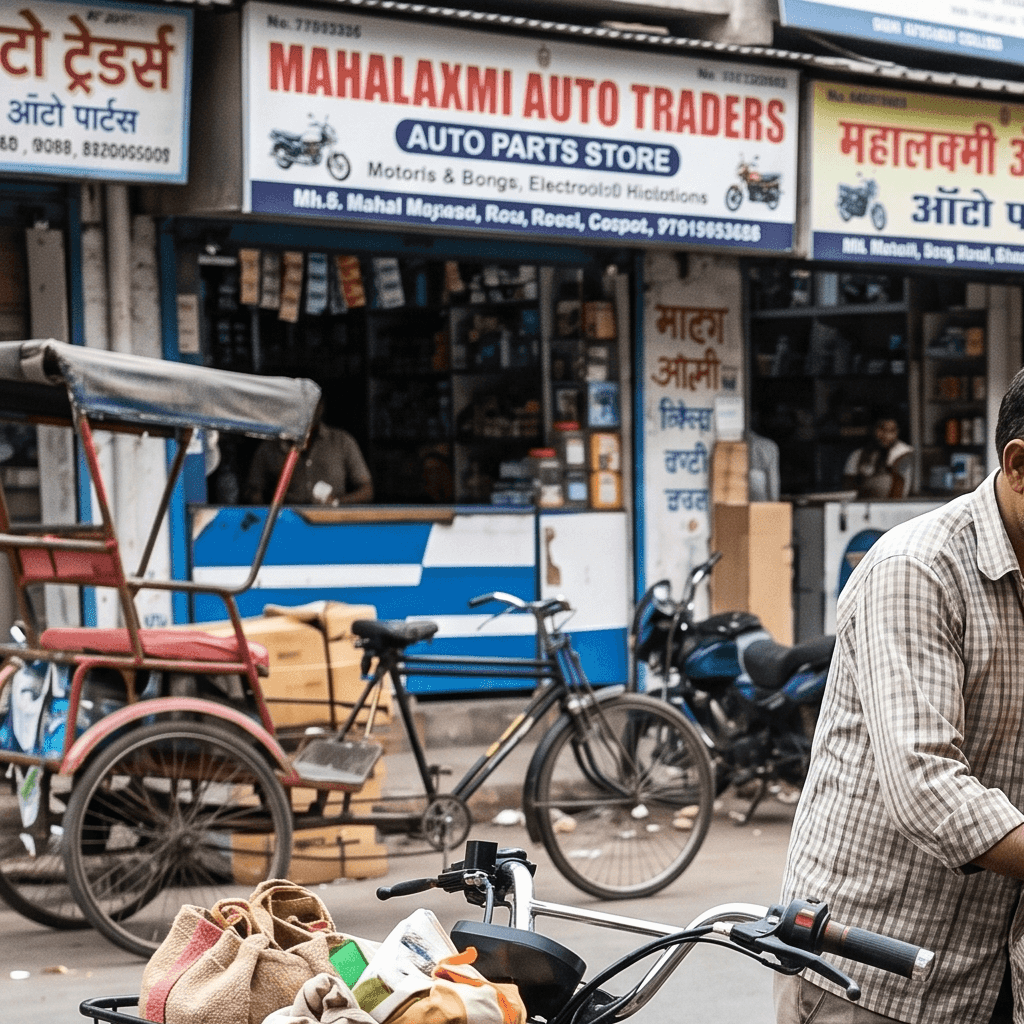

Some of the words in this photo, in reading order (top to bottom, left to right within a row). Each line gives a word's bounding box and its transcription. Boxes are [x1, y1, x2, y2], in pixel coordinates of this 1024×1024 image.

[269, 42, 512, 116] MAHALAXMI
[523, 73, 619, 127] AUTO
[630, 84, 785, 143] TRADERS
[406, 123, 486, 156] AUTO
[491, 131, 579, 165] PARTS
[584, 140, 672, 173] STORE
[443, 169, 455, 184] &
[911, 185, 993, 229] ऑटो
